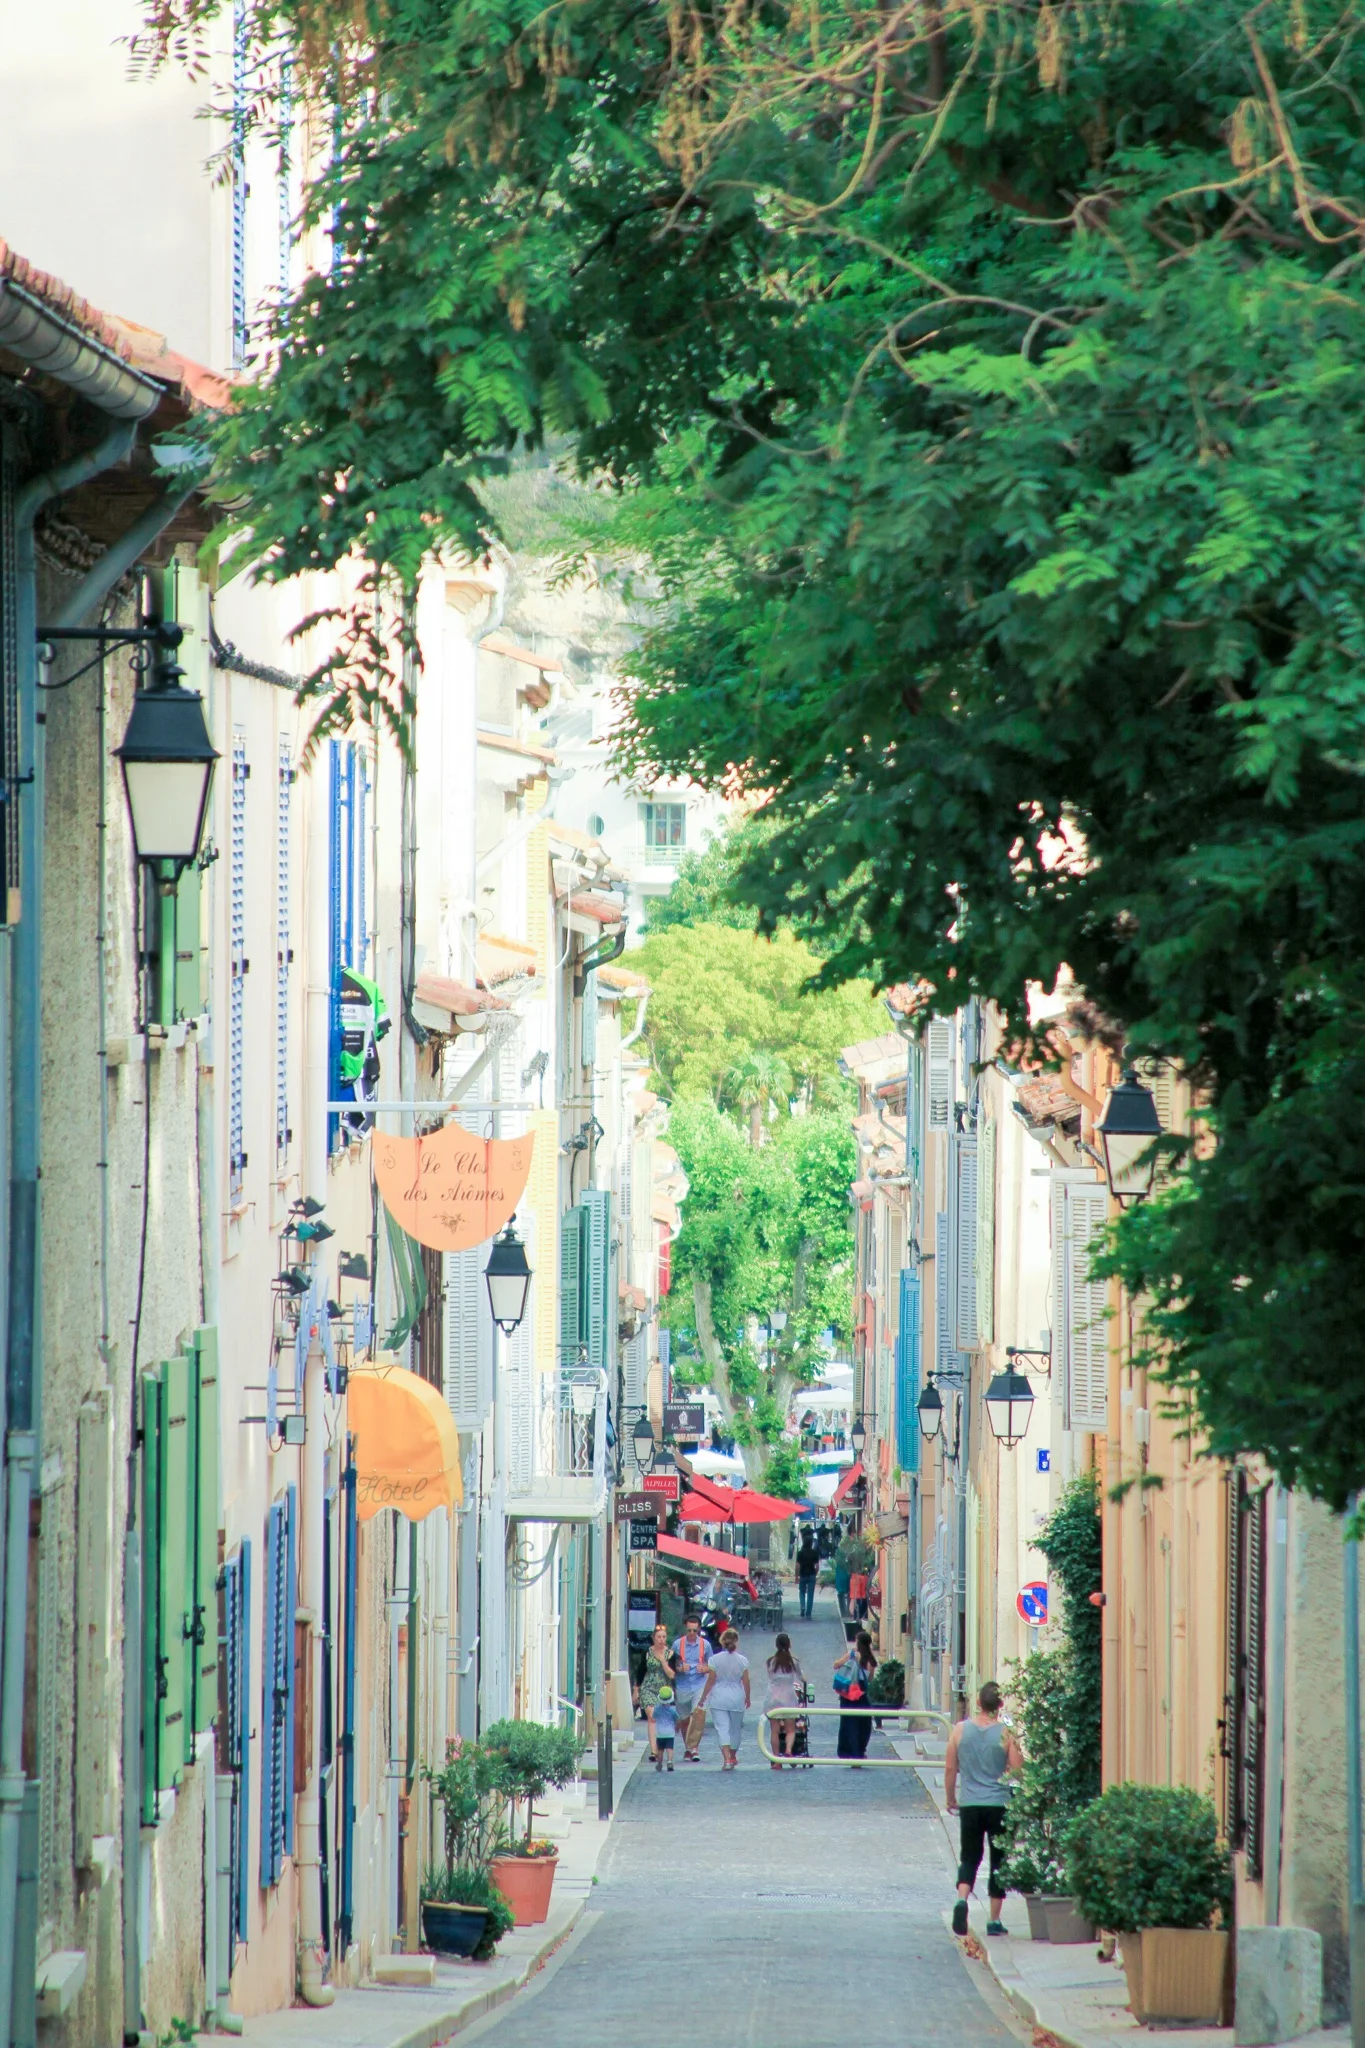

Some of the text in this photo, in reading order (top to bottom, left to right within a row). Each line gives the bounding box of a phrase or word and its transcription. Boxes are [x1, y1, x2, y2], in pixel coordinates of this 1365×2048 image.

[420, 1151, 489, 1175] Le Clos
[403, 1179, 505, 1202] des Arômes
[357, 1475, 428, 1503] Hôtel
[631, 1523, 657, 1534] CENTRE
[633, 1536, 655, 1546] SPA
